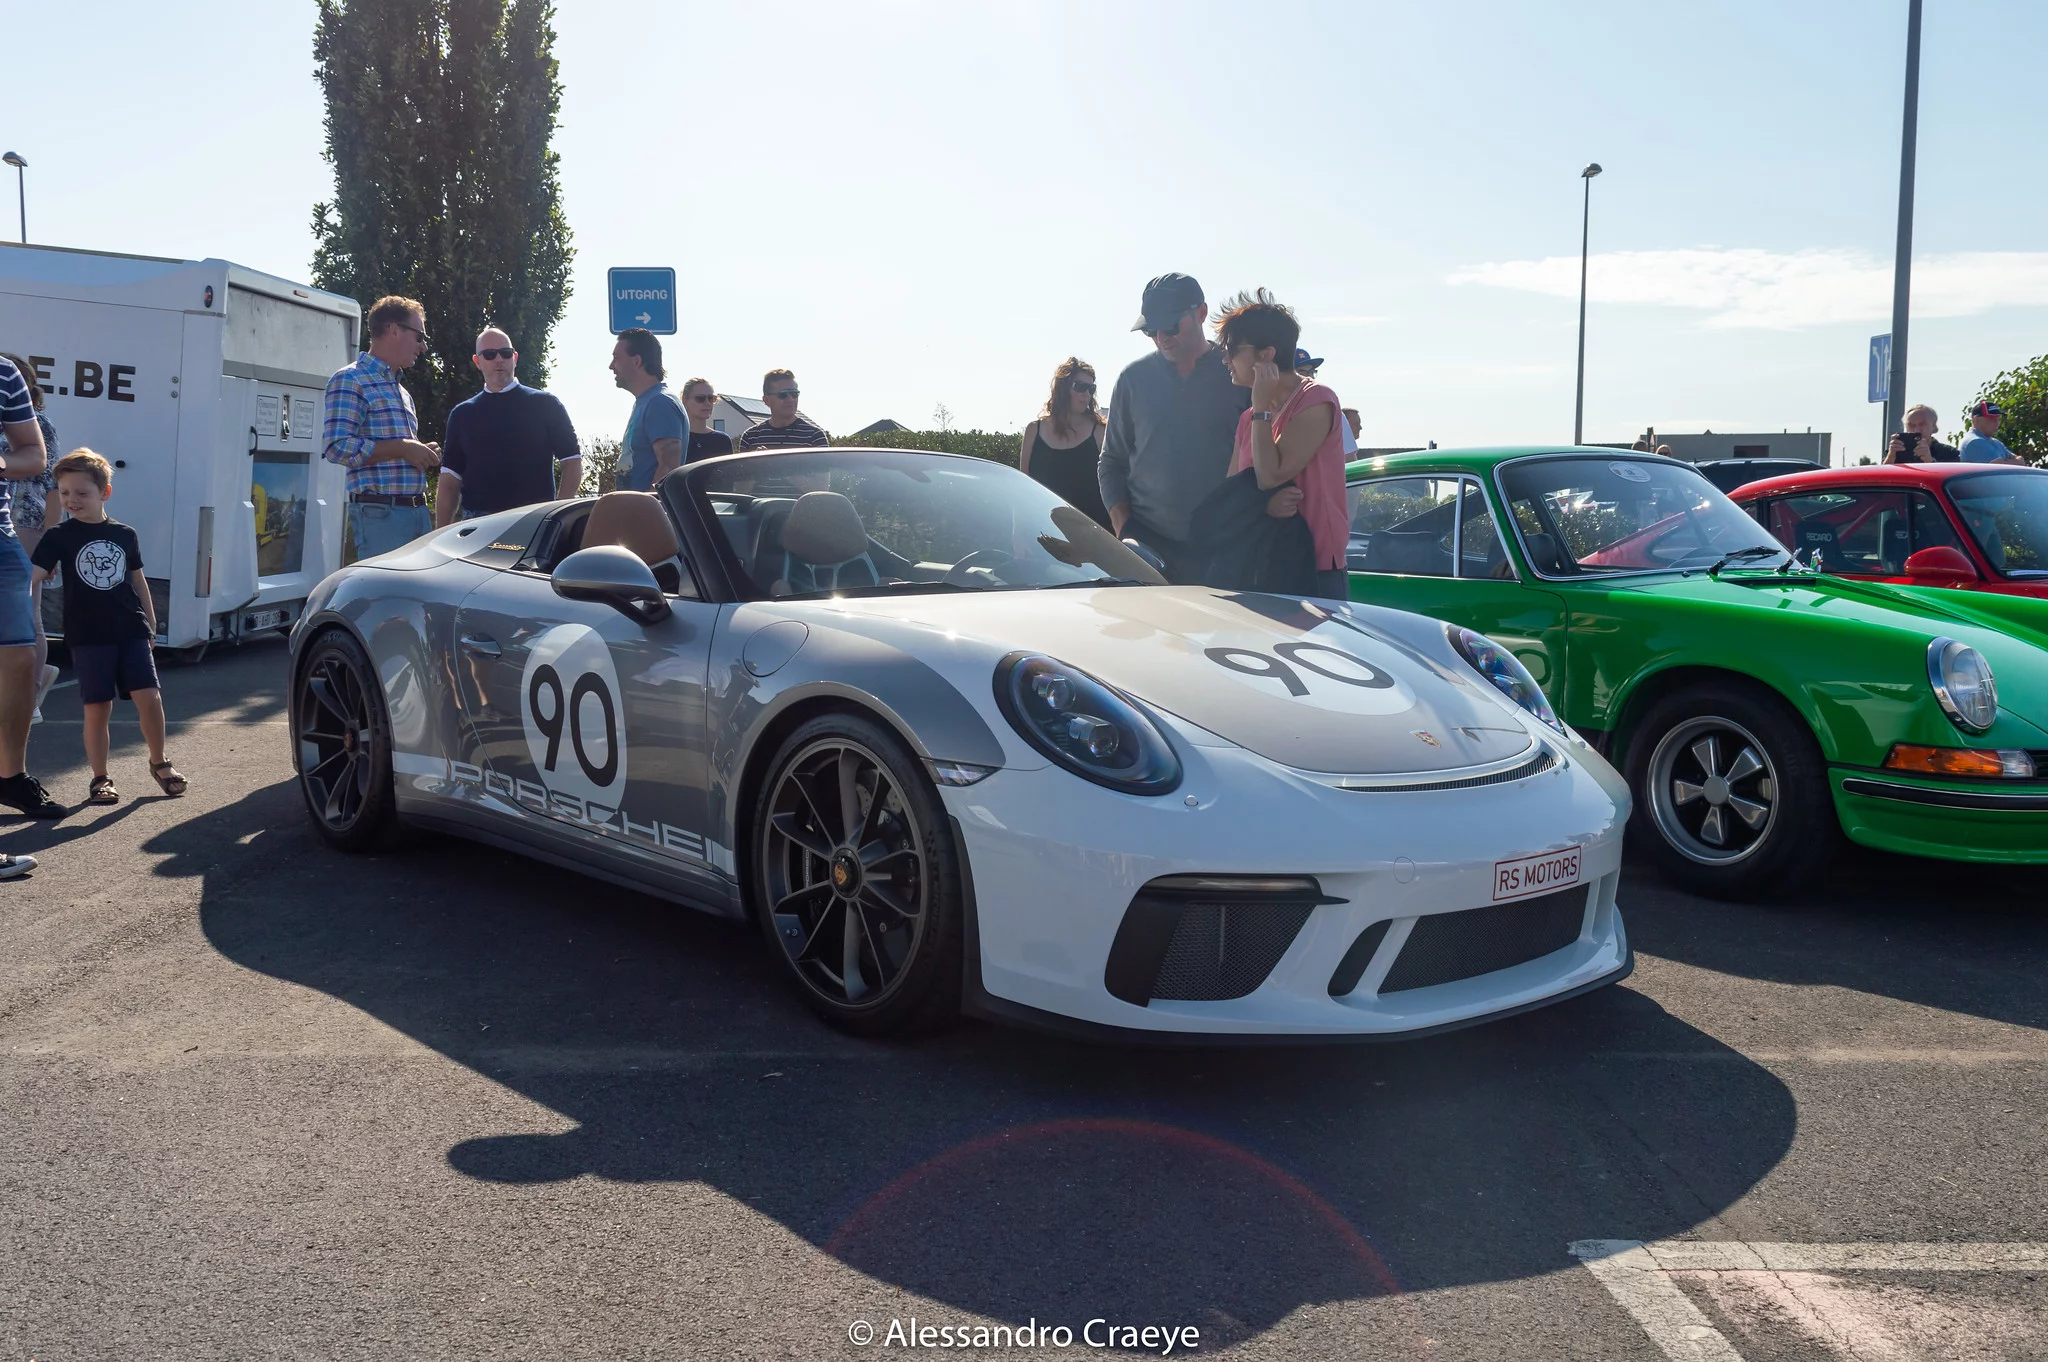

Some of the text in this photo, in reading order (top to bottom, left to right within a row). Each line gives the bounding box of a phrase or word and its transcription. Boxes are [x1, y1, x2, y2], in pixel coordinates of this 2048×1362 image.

[616, 289, 668, 300] UITGANG
[1806, 532, 1832, 542] RECARO
[1203, 641, 1395, 697] 90
[529, 663, 619, 788] 90
[450, 760, 704, 860] PORSCHE
[1499, 855, 1578, 892] RS MOTORS
